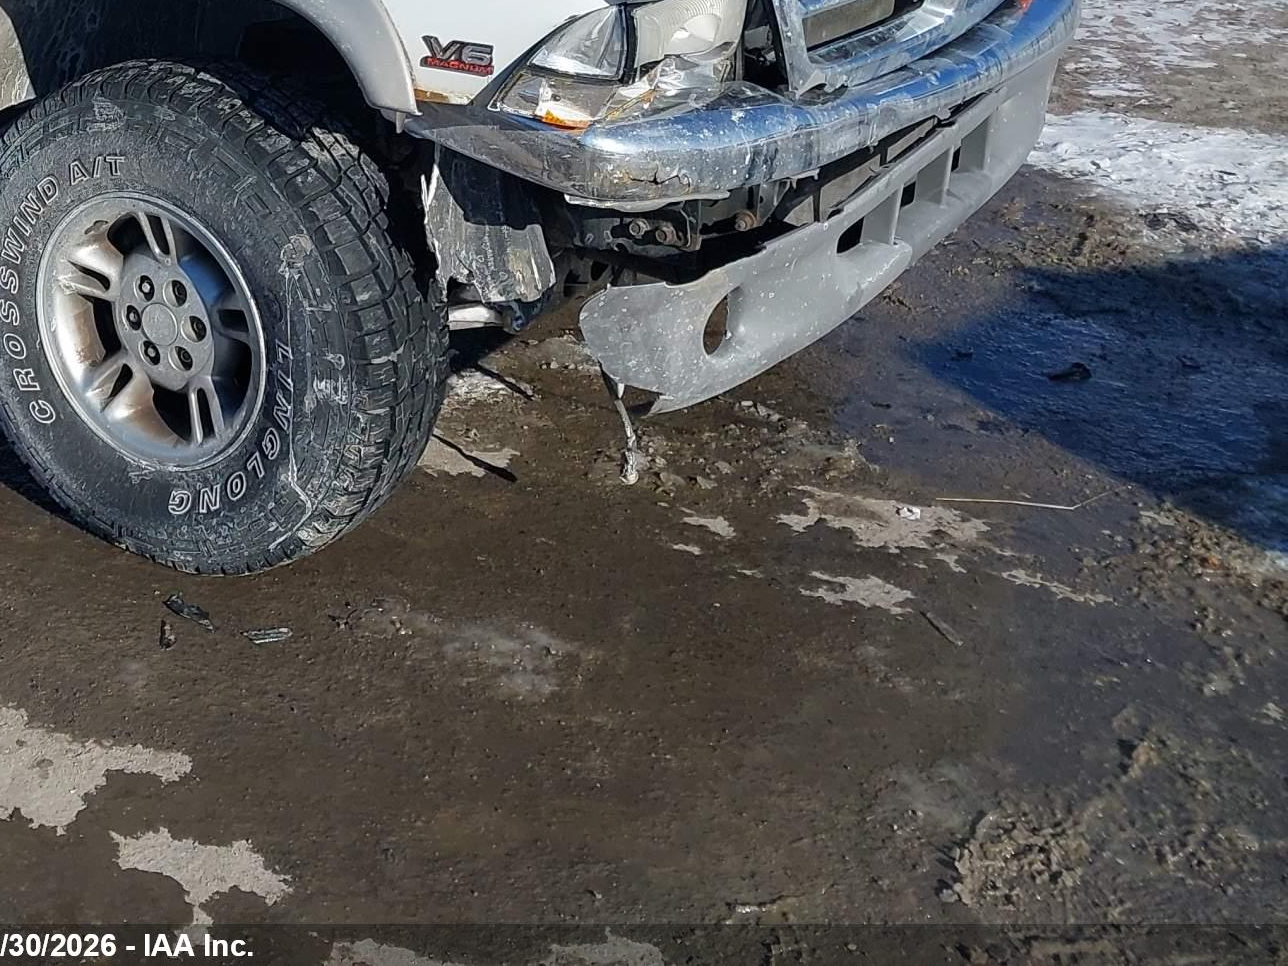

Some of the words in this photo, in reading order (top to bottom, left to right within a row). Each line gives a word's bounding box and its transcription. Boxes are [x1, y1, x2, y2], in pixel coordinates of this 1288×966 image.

[420, 34, 494, 66] V6
[425, 57, 493, 75] MAGNUM
[68, 155, 126, 186] A/T
[167, 338, 294, 516] LINGLONG
